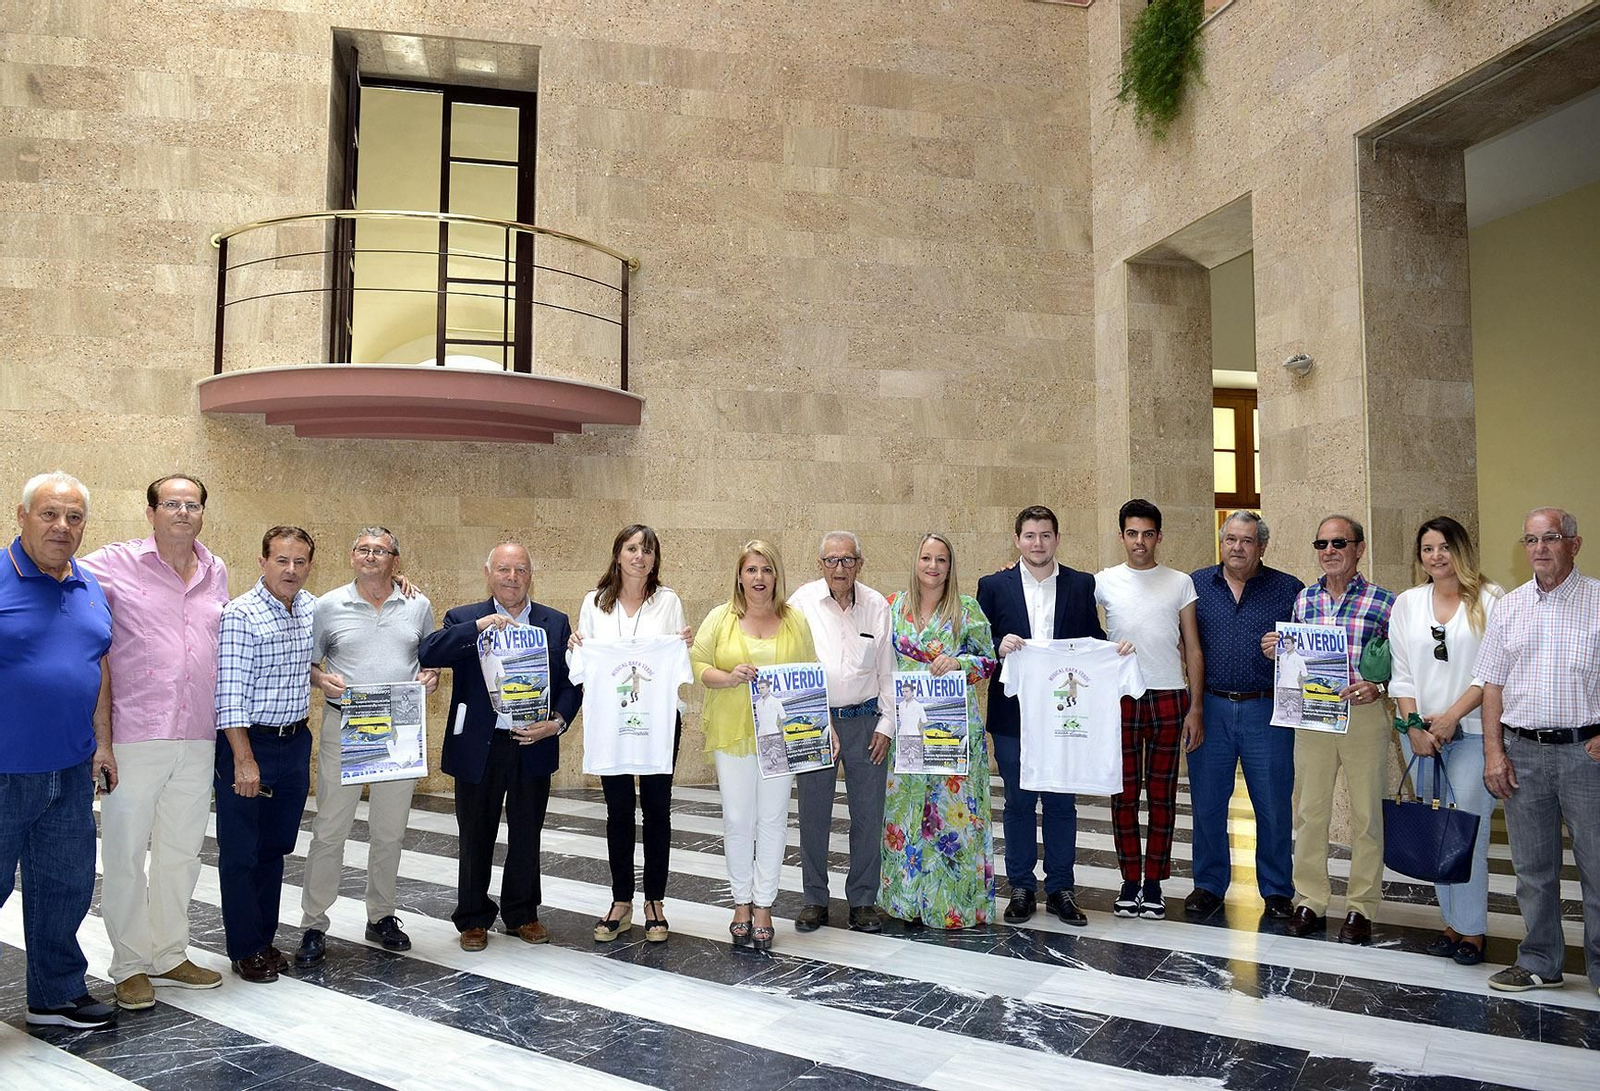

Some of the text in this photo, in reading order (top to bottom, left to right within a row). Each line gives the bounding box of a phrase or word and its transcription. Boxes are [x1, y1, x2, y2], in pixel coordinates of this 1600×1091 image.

[1307, 630, 1345, 652] VERDÚ
[783, 666, 824, 690] VERDÚ
[926, 675, 964, 697] VERDÚ
